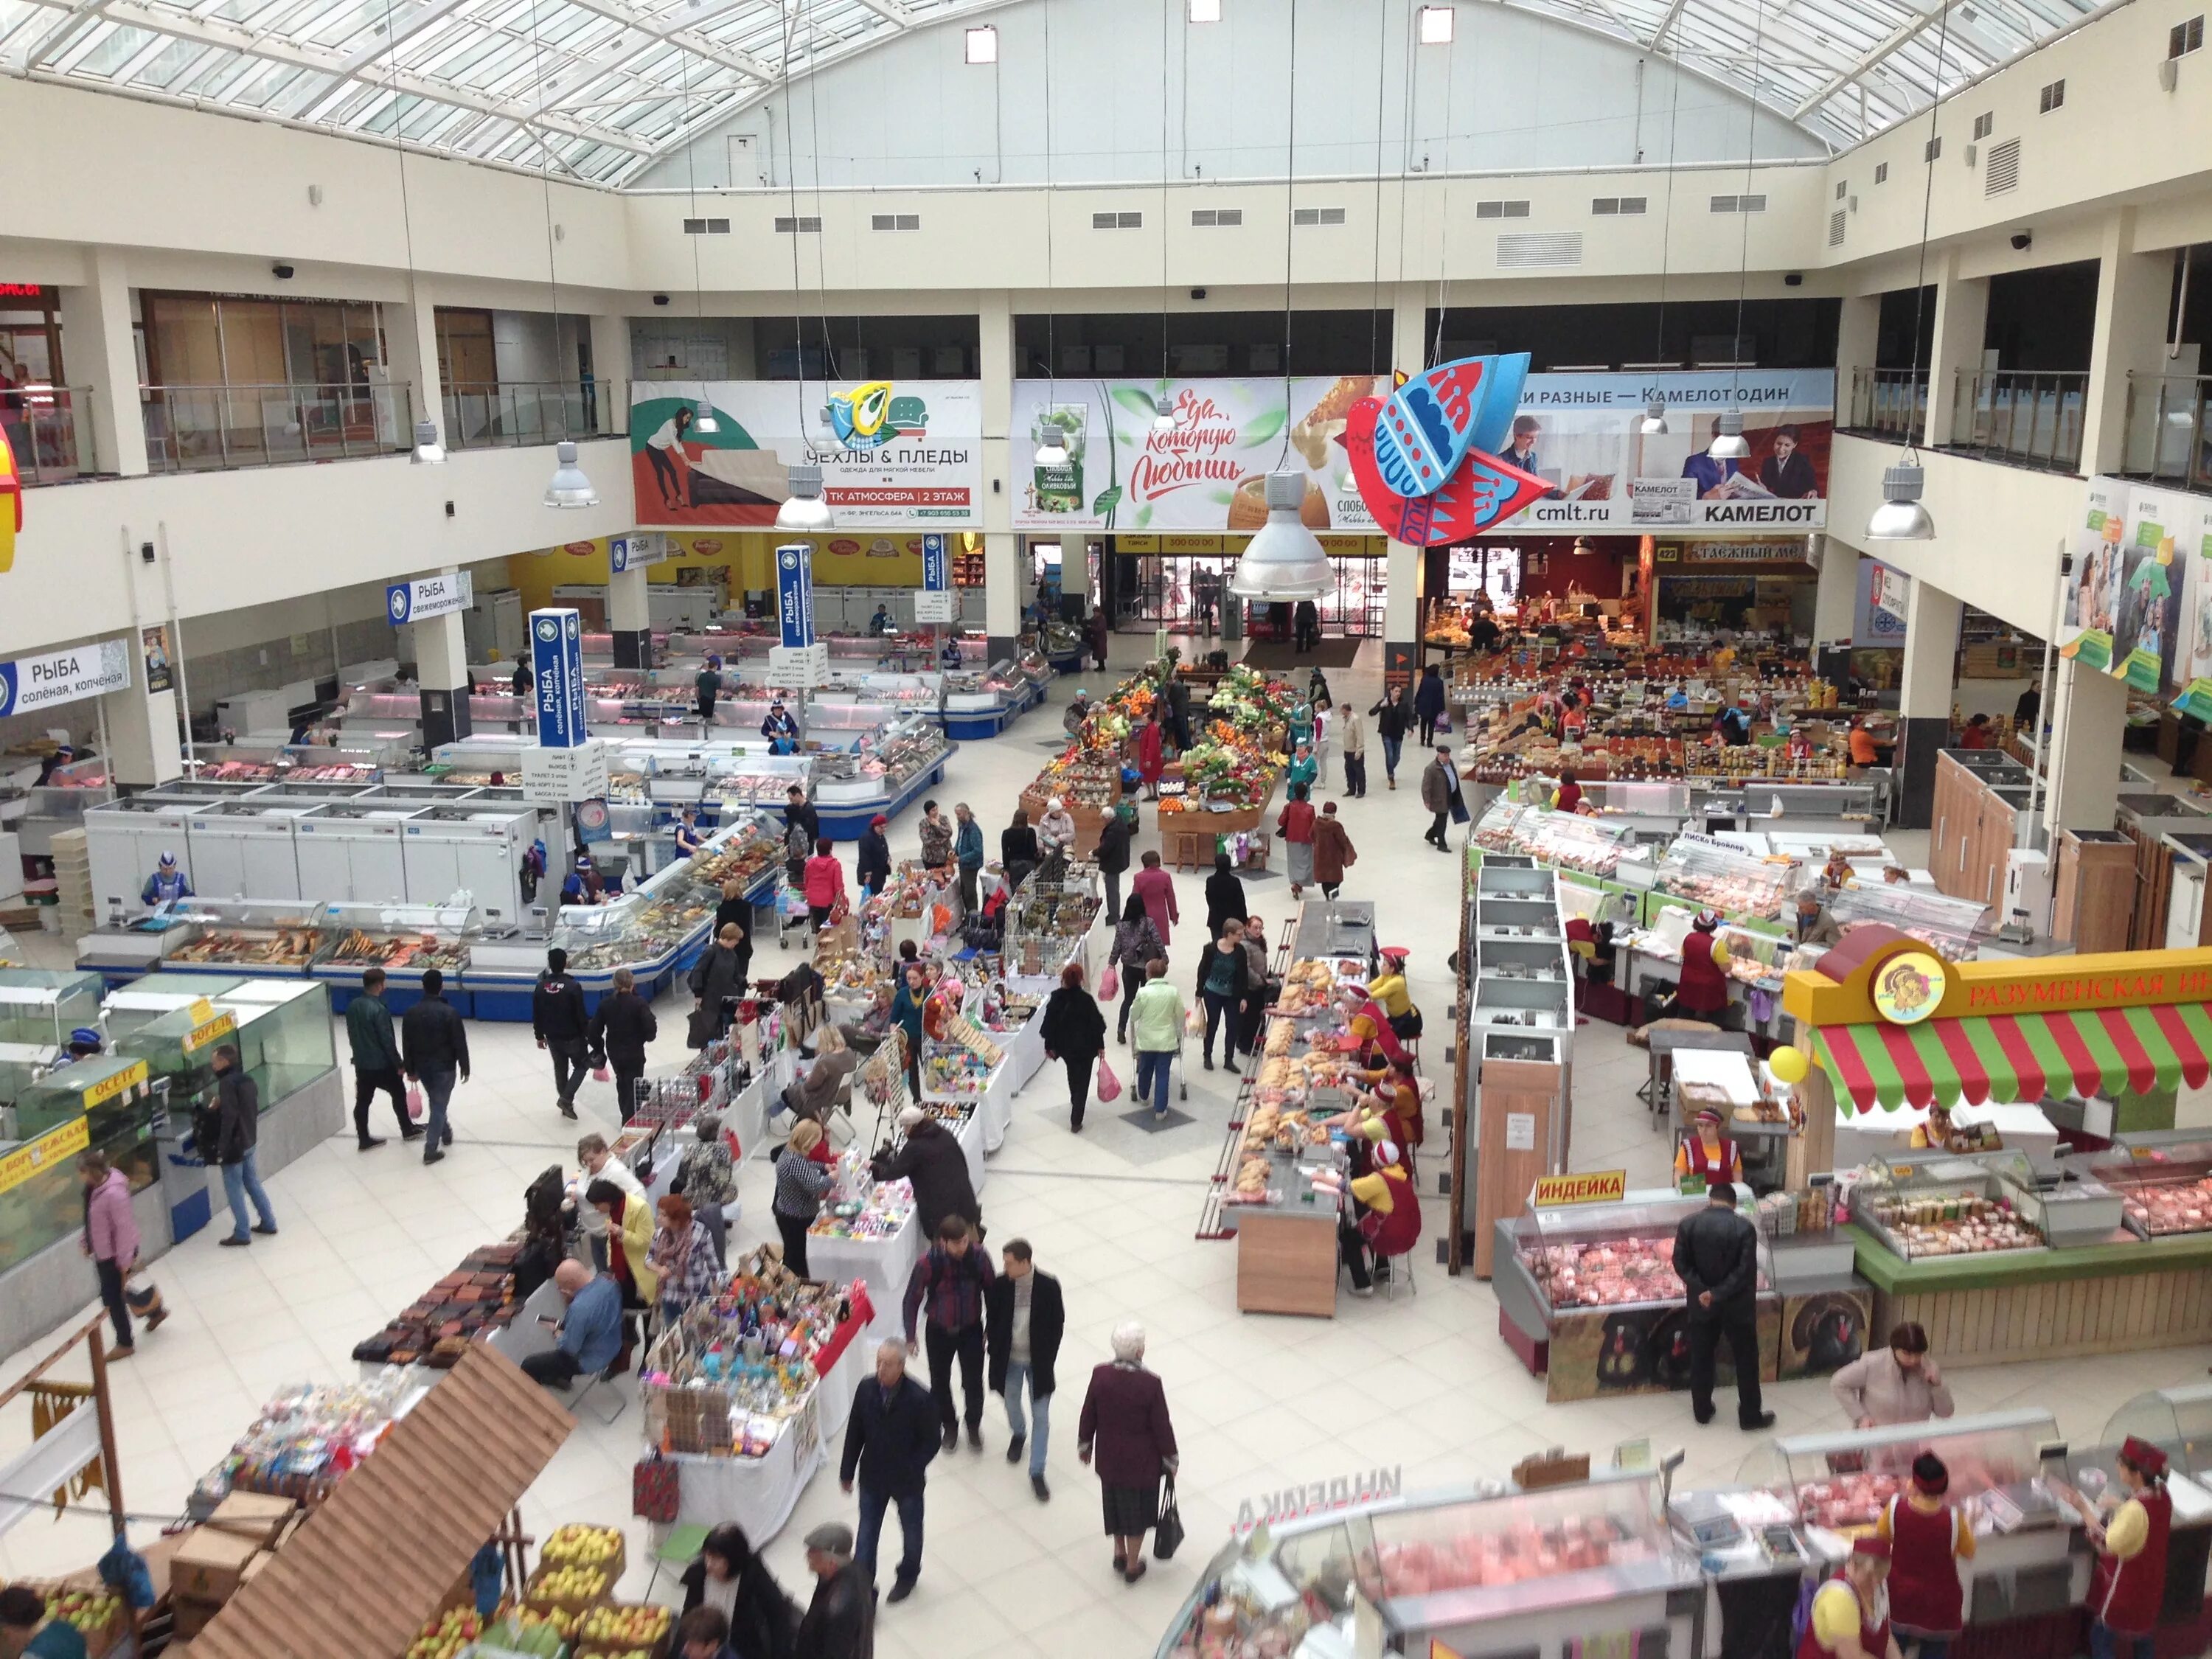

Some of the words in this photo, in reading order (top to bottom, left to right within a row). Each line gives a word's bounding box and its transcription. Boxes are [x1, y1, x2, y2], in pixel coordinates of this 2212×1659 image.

[1540, 391, 1613, 404] РАЗНЫЕ
[1736, 387, 1790, 402] ОДИН
[881, 450, 891, 464] &
[899, 450, 968, 466] ПЛЕДЫ
[883, 465, 908, 473] МЯГКОЙ
[830, 492, 844, 501] ТК
[847, 492, 915, 501] АТМОСФЕРА
[923, 492, 930, 501] 2
[933, 492, 964, 501] ЭТАЖ
[1635, 485, 1678, 493] КАМЕЛОТ
[1337, 500, 1368, 512] СЛОБО
[1536, 504, 1610, 521] cmlt.ru
[1705, 504, 1817, 522] КАМЕЛОТ
[631, 539, 650, 553] РЫБА
[1169, 538, 1186, 547] 300
[1187, 538, 1200, 547] 00
[1200, 538, 1214, 547] 00
[1659, 549, 1677, 559] 423
[928, 555, 936, 582] РЫБА
[418, 581, 445, 599] РЫБА
[412, 595, 466, 614] свежемороженая
[784, 591, 795, 625] РЫБА
[32, 657, 80, 684] РЫБА
[21, 684, 72, 704] солёная,
[541, 669, 555, 713] РЫБА
[1711, 838, 1745, 852] Бройлер
[1969, 973, 2165, 1008] РАЗУМЕНСКАЯ
[94, 1066, 136, 1097] ОСЕТР
[1538, 1175, 1621, 1200] ИНДЕЙКА
